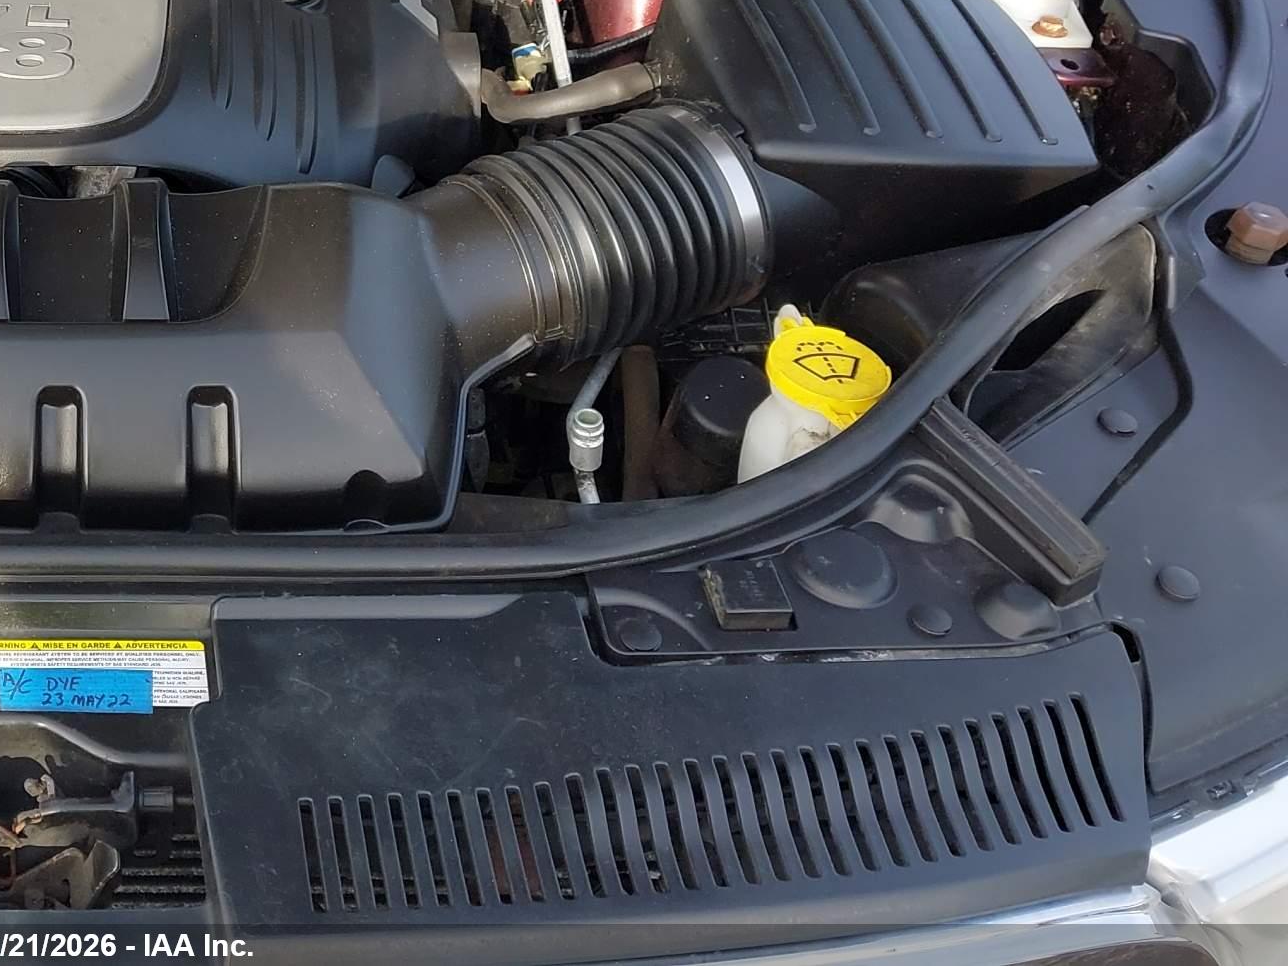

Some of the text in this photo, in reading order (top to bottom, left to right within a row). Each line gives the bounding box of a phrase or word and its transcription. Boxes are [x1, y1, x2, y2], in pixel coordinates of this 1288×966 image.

[1, 668, 33, 700] A/C
[46, 676, 82, 692] DYE
[41, 692, 132, 708] 23 MAY 22
